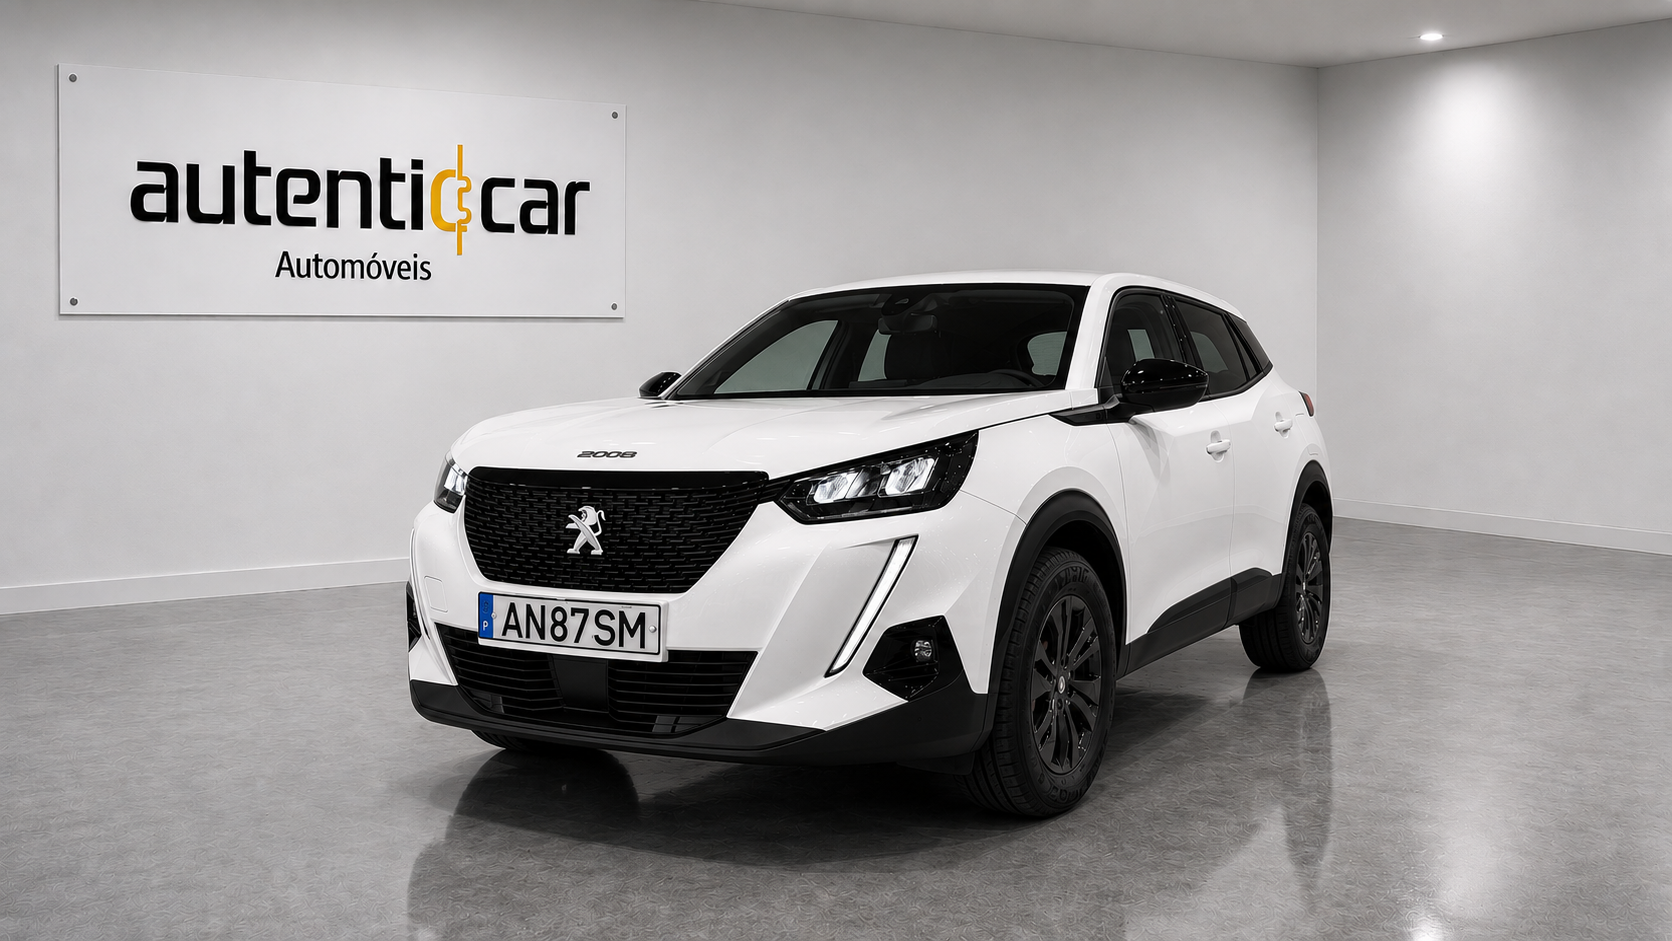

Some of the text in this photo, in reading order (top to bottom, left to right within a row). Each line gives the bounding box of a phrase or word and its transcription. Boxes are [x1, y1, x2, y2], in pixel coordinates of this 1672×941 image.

[275, 250, 431, 281] Automóveis
[577, 450, 638, 459] 2008
[482, 620, 489, 631] P
[502, 602, 645, 649] AN87SM
